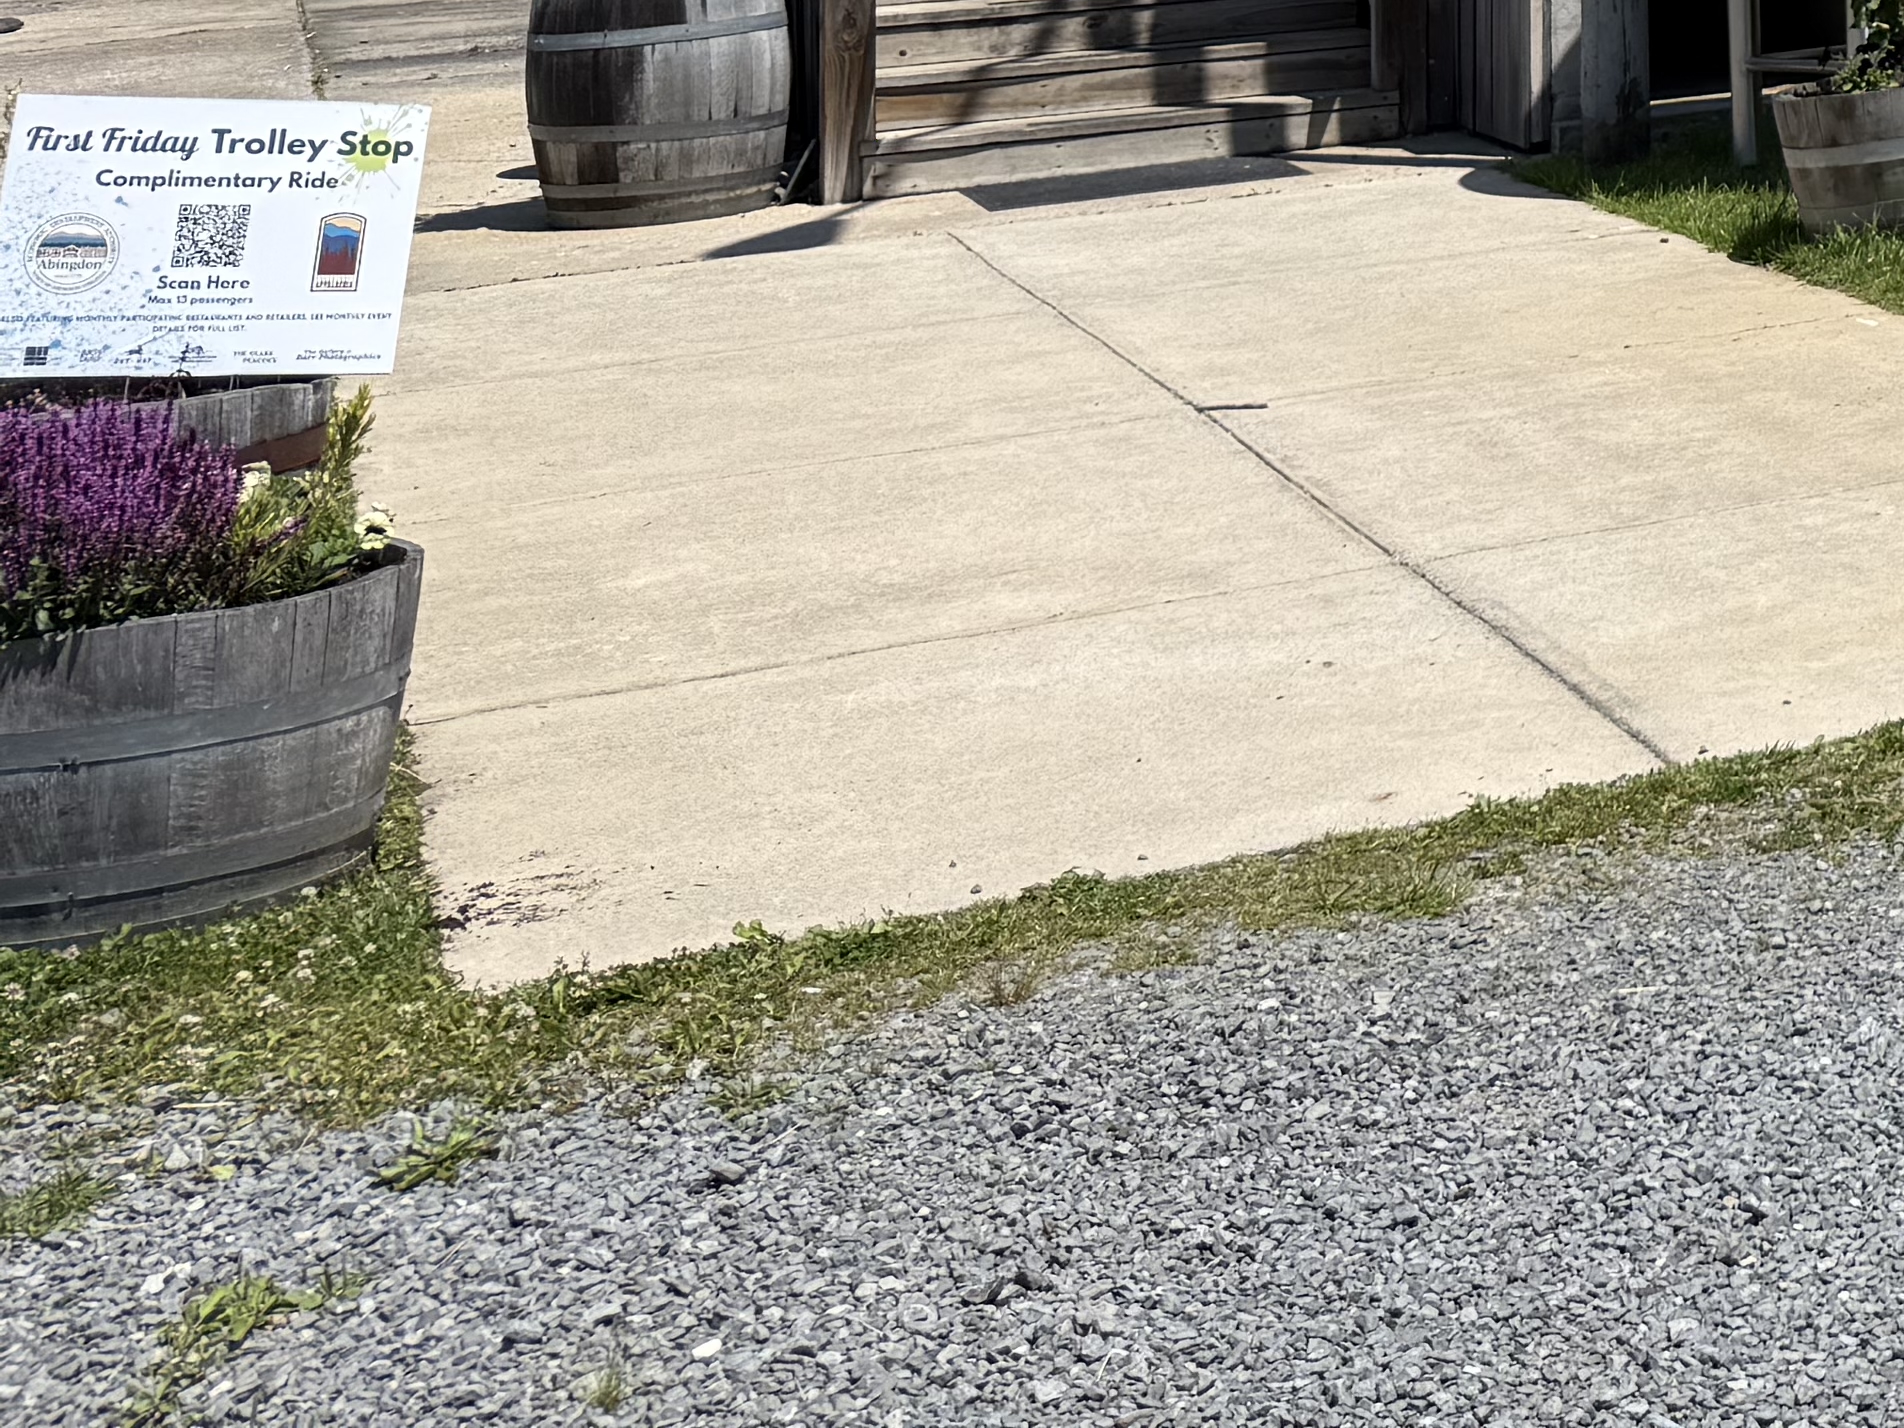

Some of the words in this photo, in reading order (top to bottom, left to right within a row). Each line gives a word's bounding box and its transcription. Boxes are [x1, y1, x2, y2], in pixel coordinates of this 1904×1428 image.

[26, 126, 94, 153] First
[102, 127, 201, 161] Friday
[211, 128, 329, 163] Trolley
[336, 130, 414, 164] Stop
[96, 169, 283, 194] Complimentary
[288, 170, 339, 190] Ride
[37, 259, 103, 272] Abingdon
[156, 274, 202, 291] Scan
[207, 274, 251, 291] Here
[148, 295, 172, 305] Max
[190, 296, 254, 307] passengers
